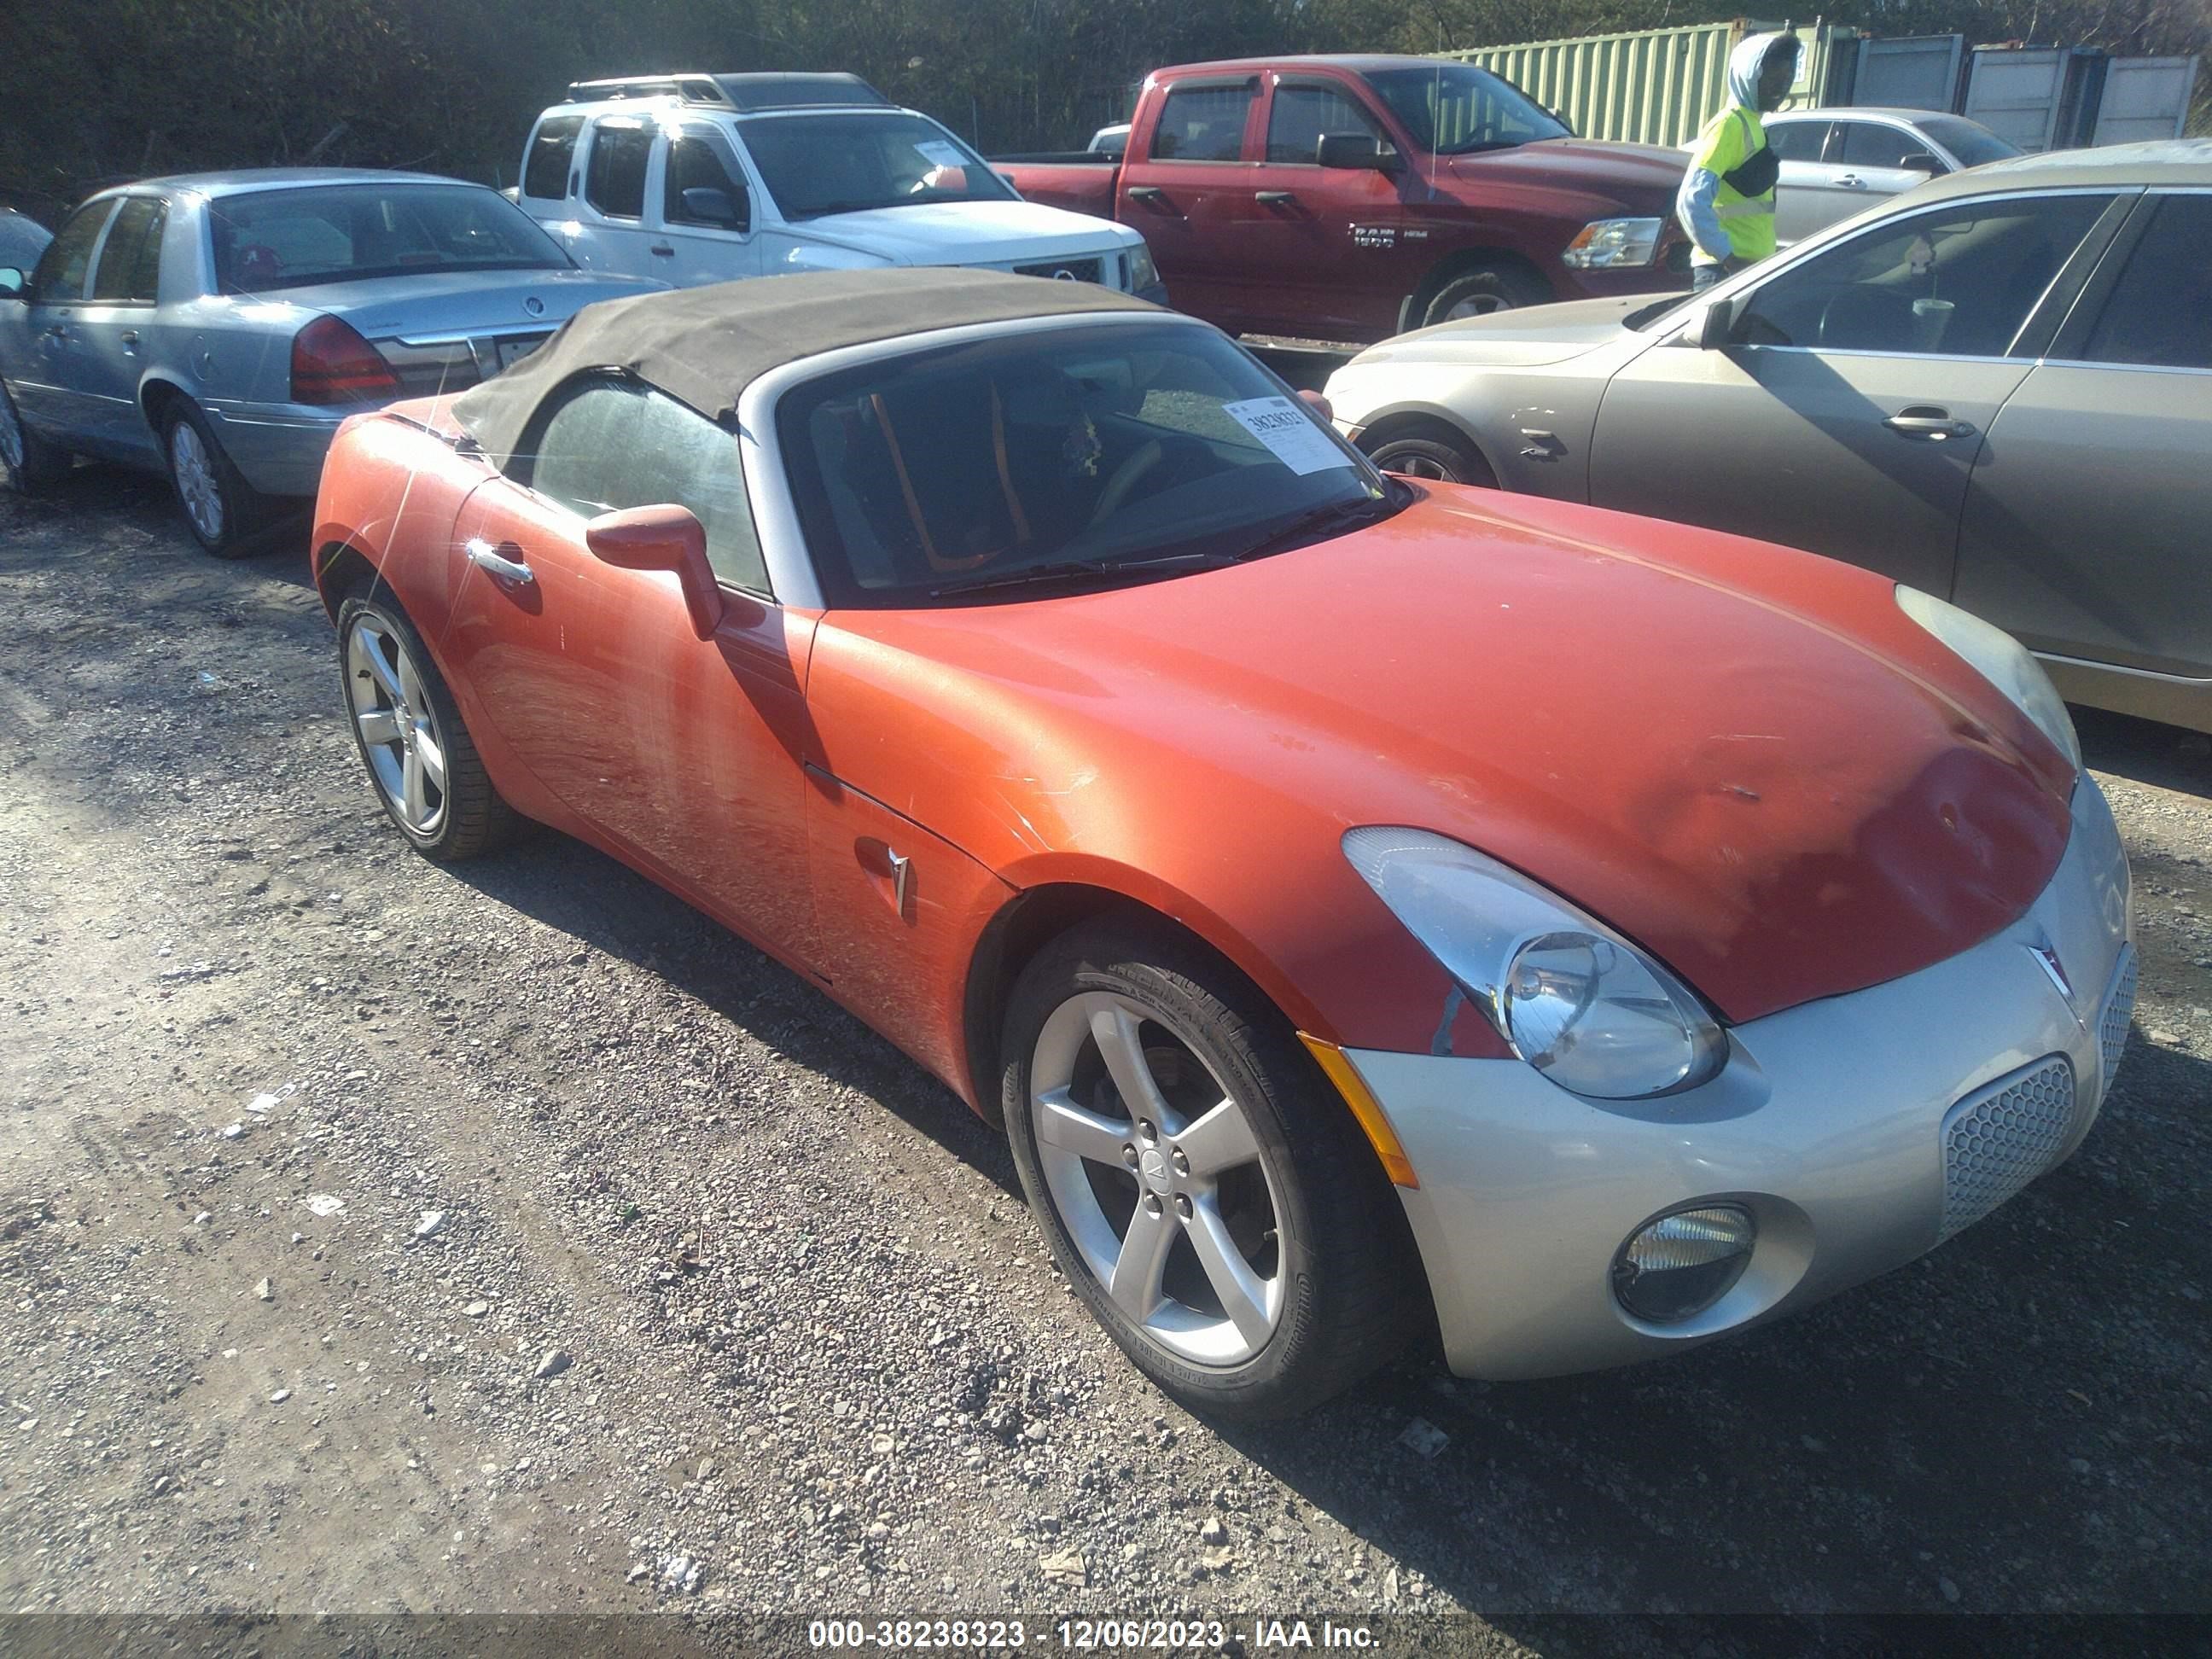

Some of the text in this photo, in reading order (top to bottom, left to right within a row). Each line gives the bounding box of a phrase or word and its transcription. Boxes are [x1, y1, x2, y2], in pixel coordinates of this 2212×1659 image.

[1354, 227, 1395, 236] RAM
[1353, 236, 1395, 247] 1500
[1247, 411, 1305, 432] 38238323
